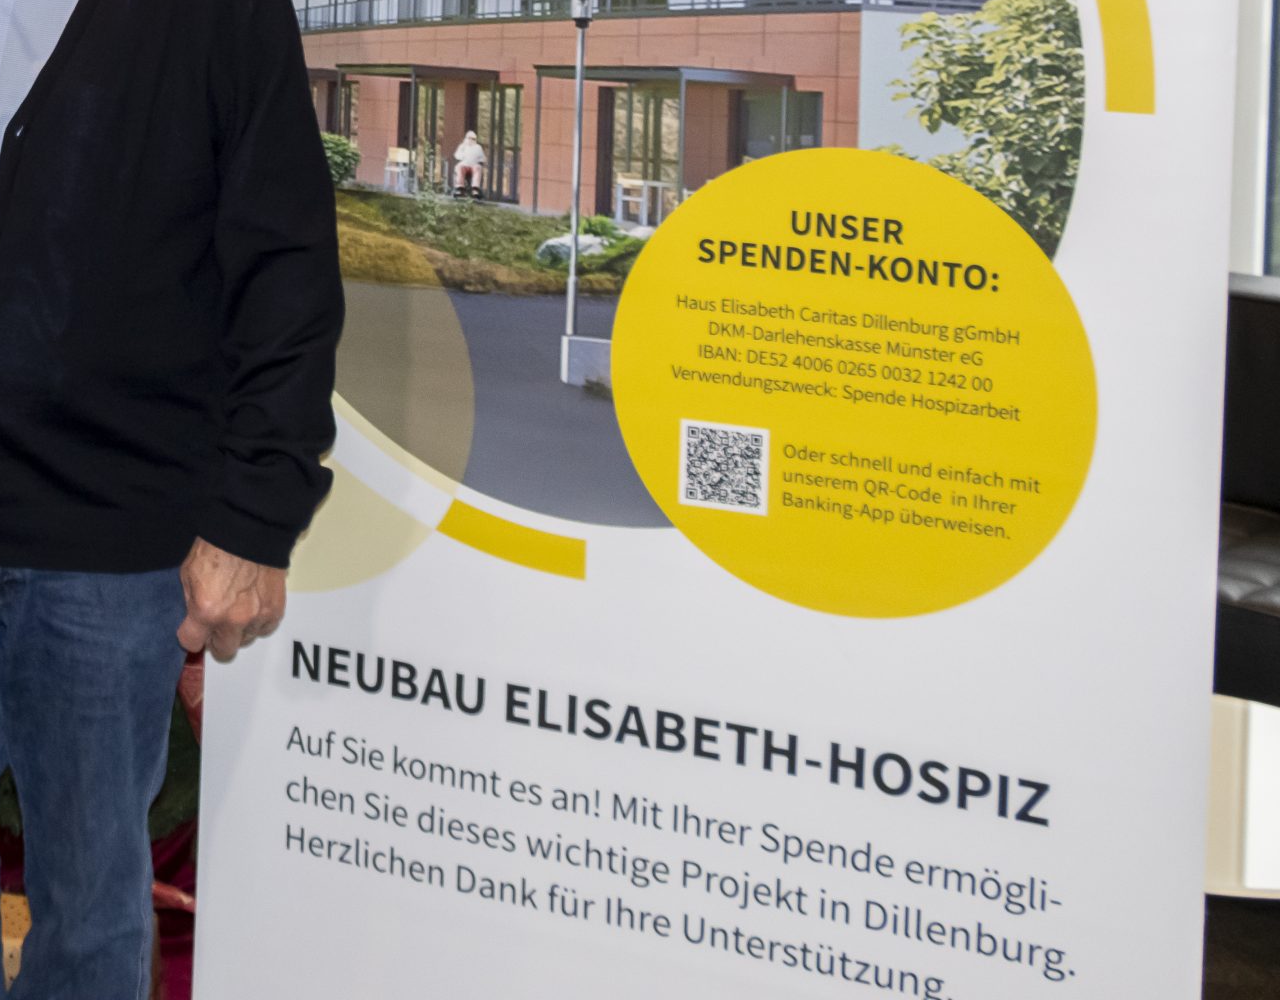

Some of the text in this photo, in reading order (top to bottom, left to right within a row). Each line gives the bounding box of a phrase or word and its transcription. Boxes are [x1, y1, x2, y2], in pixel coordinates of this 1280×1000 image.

[792, 211, 903, 244] UNSER
[698, 239, 998, 292] SPENDEN-KONTO:
[677, 295, 1020, 345] Haus Elisabeth Caritas Dillenburg gGmbH
[709, 322, 983, 366] DKM-Darlehenskasse Münster eG
[672, 365, 1020, 421] Verwendungszweck: Spende Hospizarbeit
[699, 345, 993, 392] IBAN: DE52 4006 0265 0032 1242 00
[783, 444, 1040, 493] Oder schnell und einfach mit
[783, 472, 1016, 514] unserem QR-Code in Ihrer
[782, 492, 1010, 539] Banking-App überweisen.
[292, 640, 1049, 827] NEUBAU ELISABETH-HOSPIZ
[287, 726, 1061, 914] Auf Sie kommt es an! Mit Ihrer Spende ermögli-
[286, 776, 1075, 981] chen Sie dieses wichtige Projekt in Dillenburg.
[286, 824, 444, 887] Herzlichen
[457, 865, 537, 909] Dank
[548, 884, 595, 919] für
[607, 898, 670, 937] Ihre
